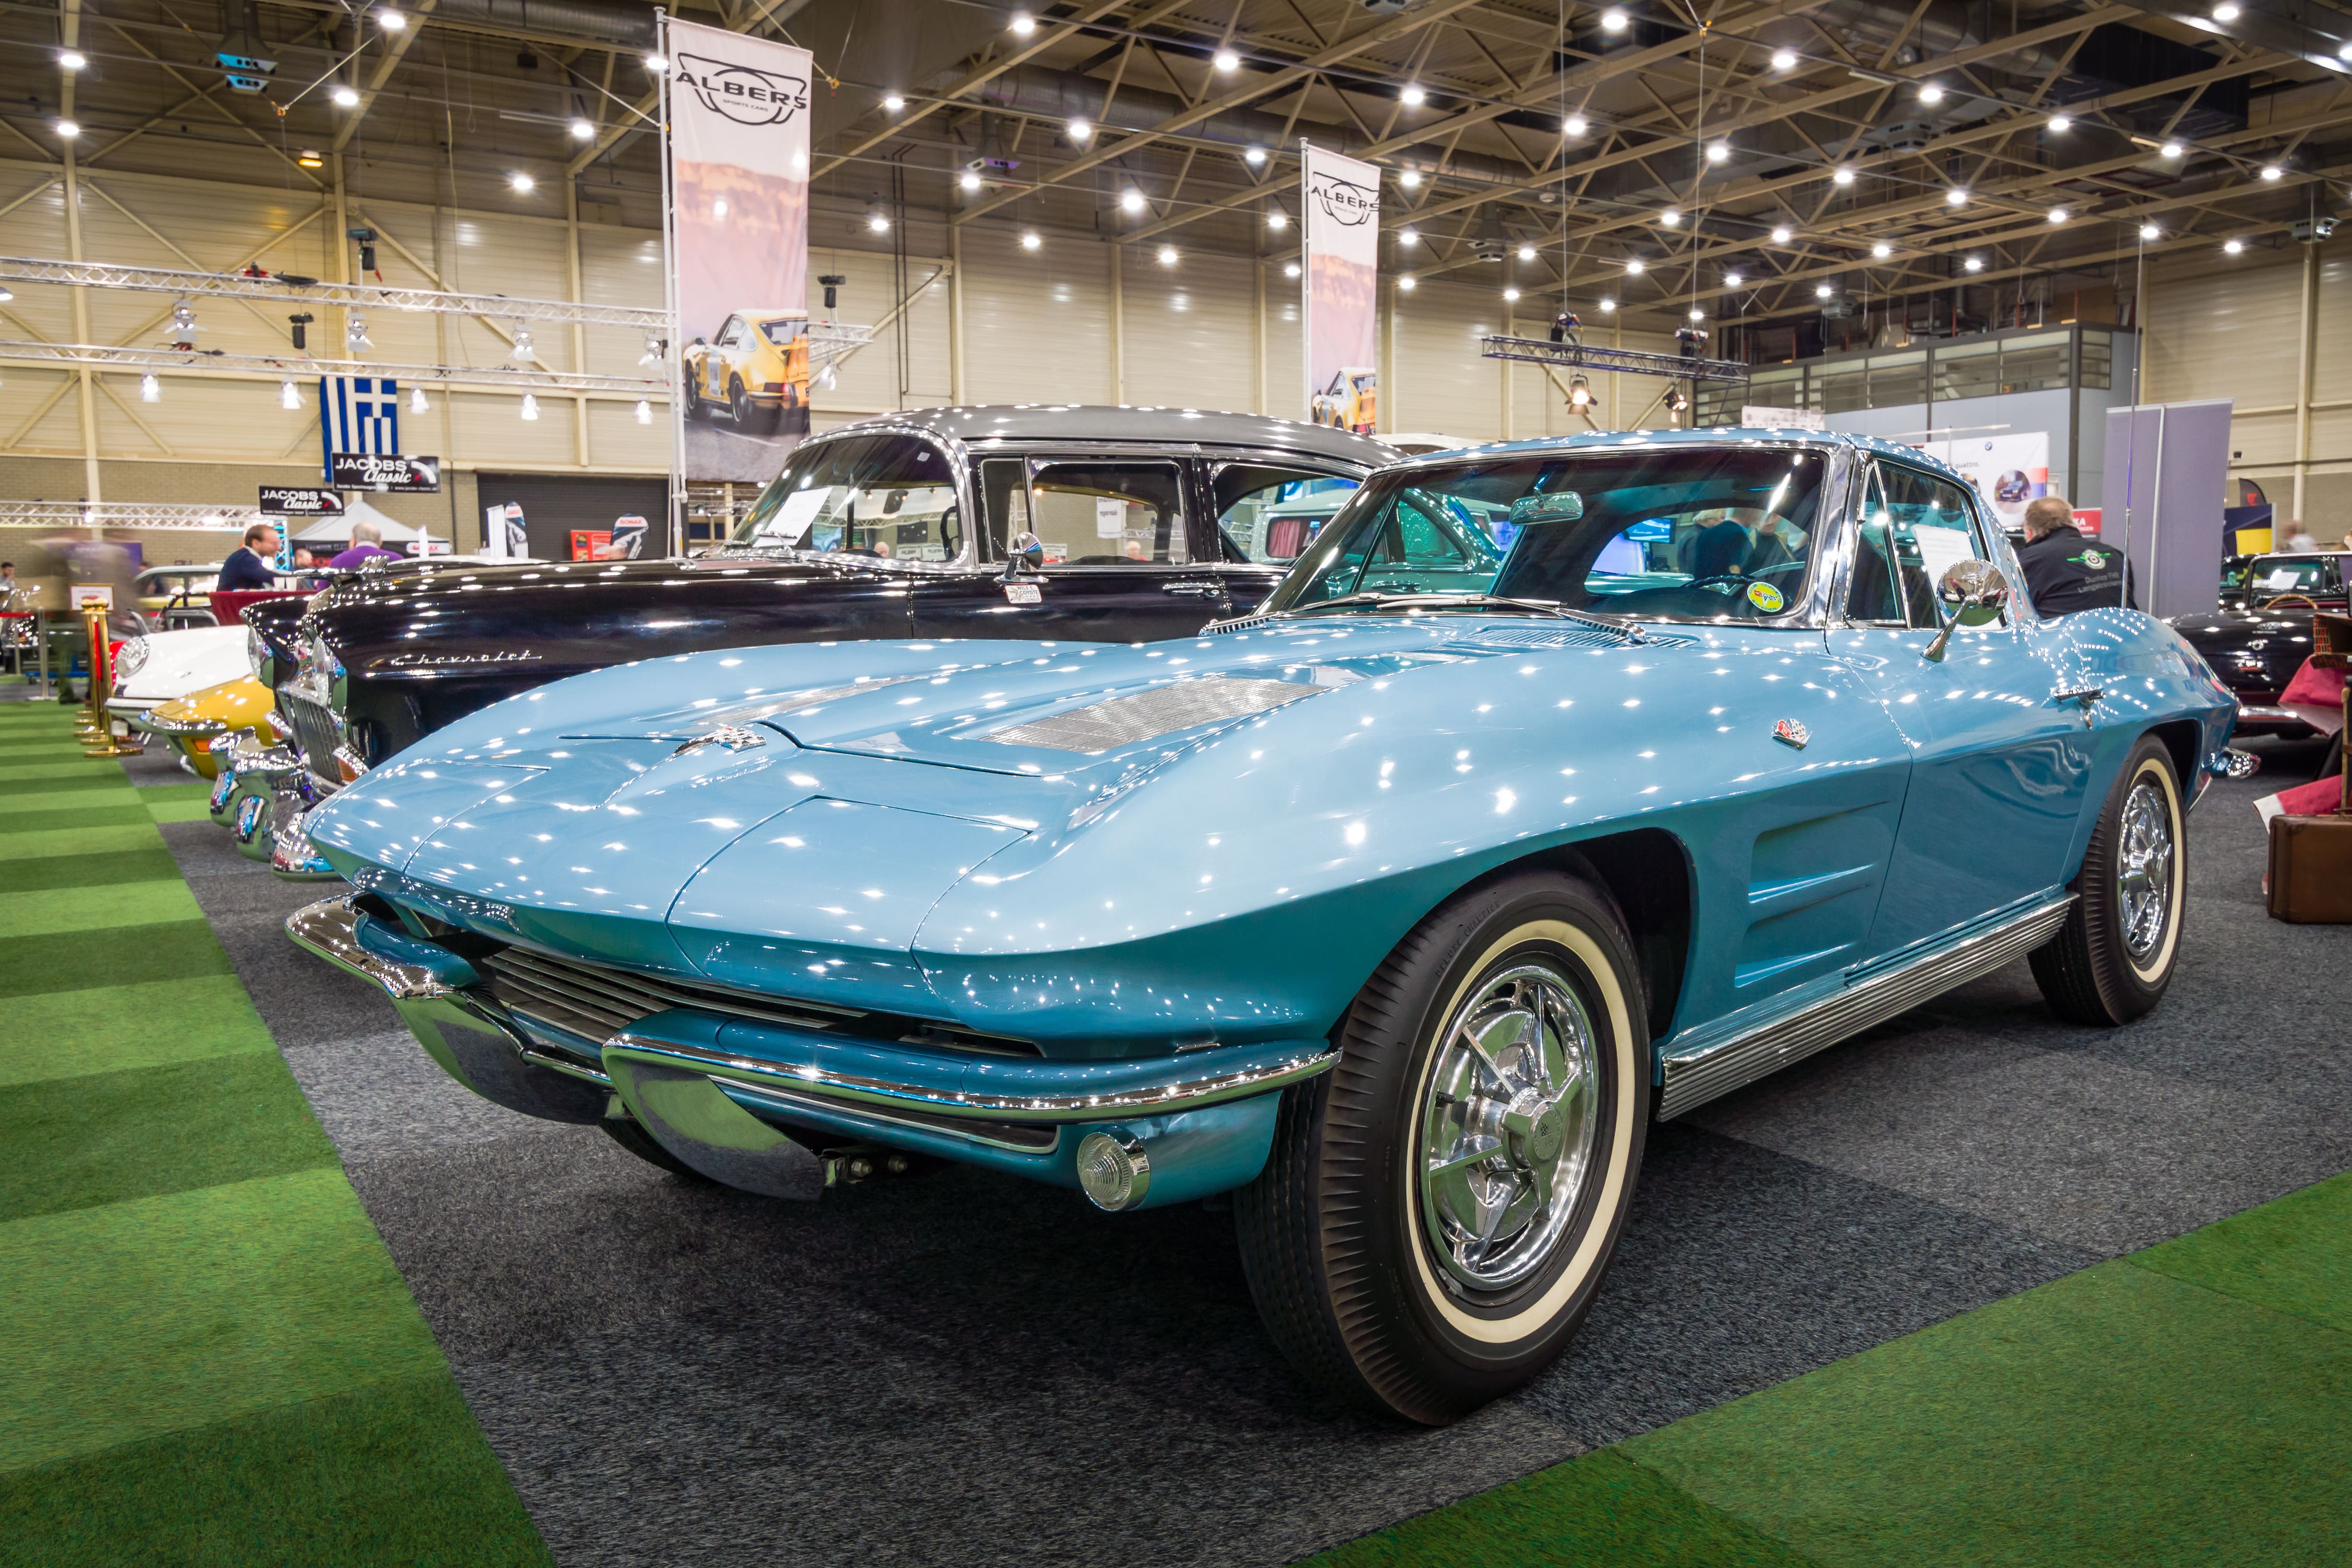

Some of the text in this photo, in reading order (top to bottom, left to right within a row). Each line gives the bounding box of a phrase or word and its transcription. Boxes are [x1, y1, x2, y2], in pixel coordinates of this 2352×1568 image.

[676, 72, 807, 110] ALBERS
[723, 99, 749, 108] SPORTS
[1311, 186, 1379, 212] ALBERS
[336, 458, 407, 471] JACOBS
[363, 470, 411, 483] Classic
[261, 489, 318, 501] JACOBS
[283, 499, 322, 509] Classic
[390, 650, 542, 666] Chevrolet
